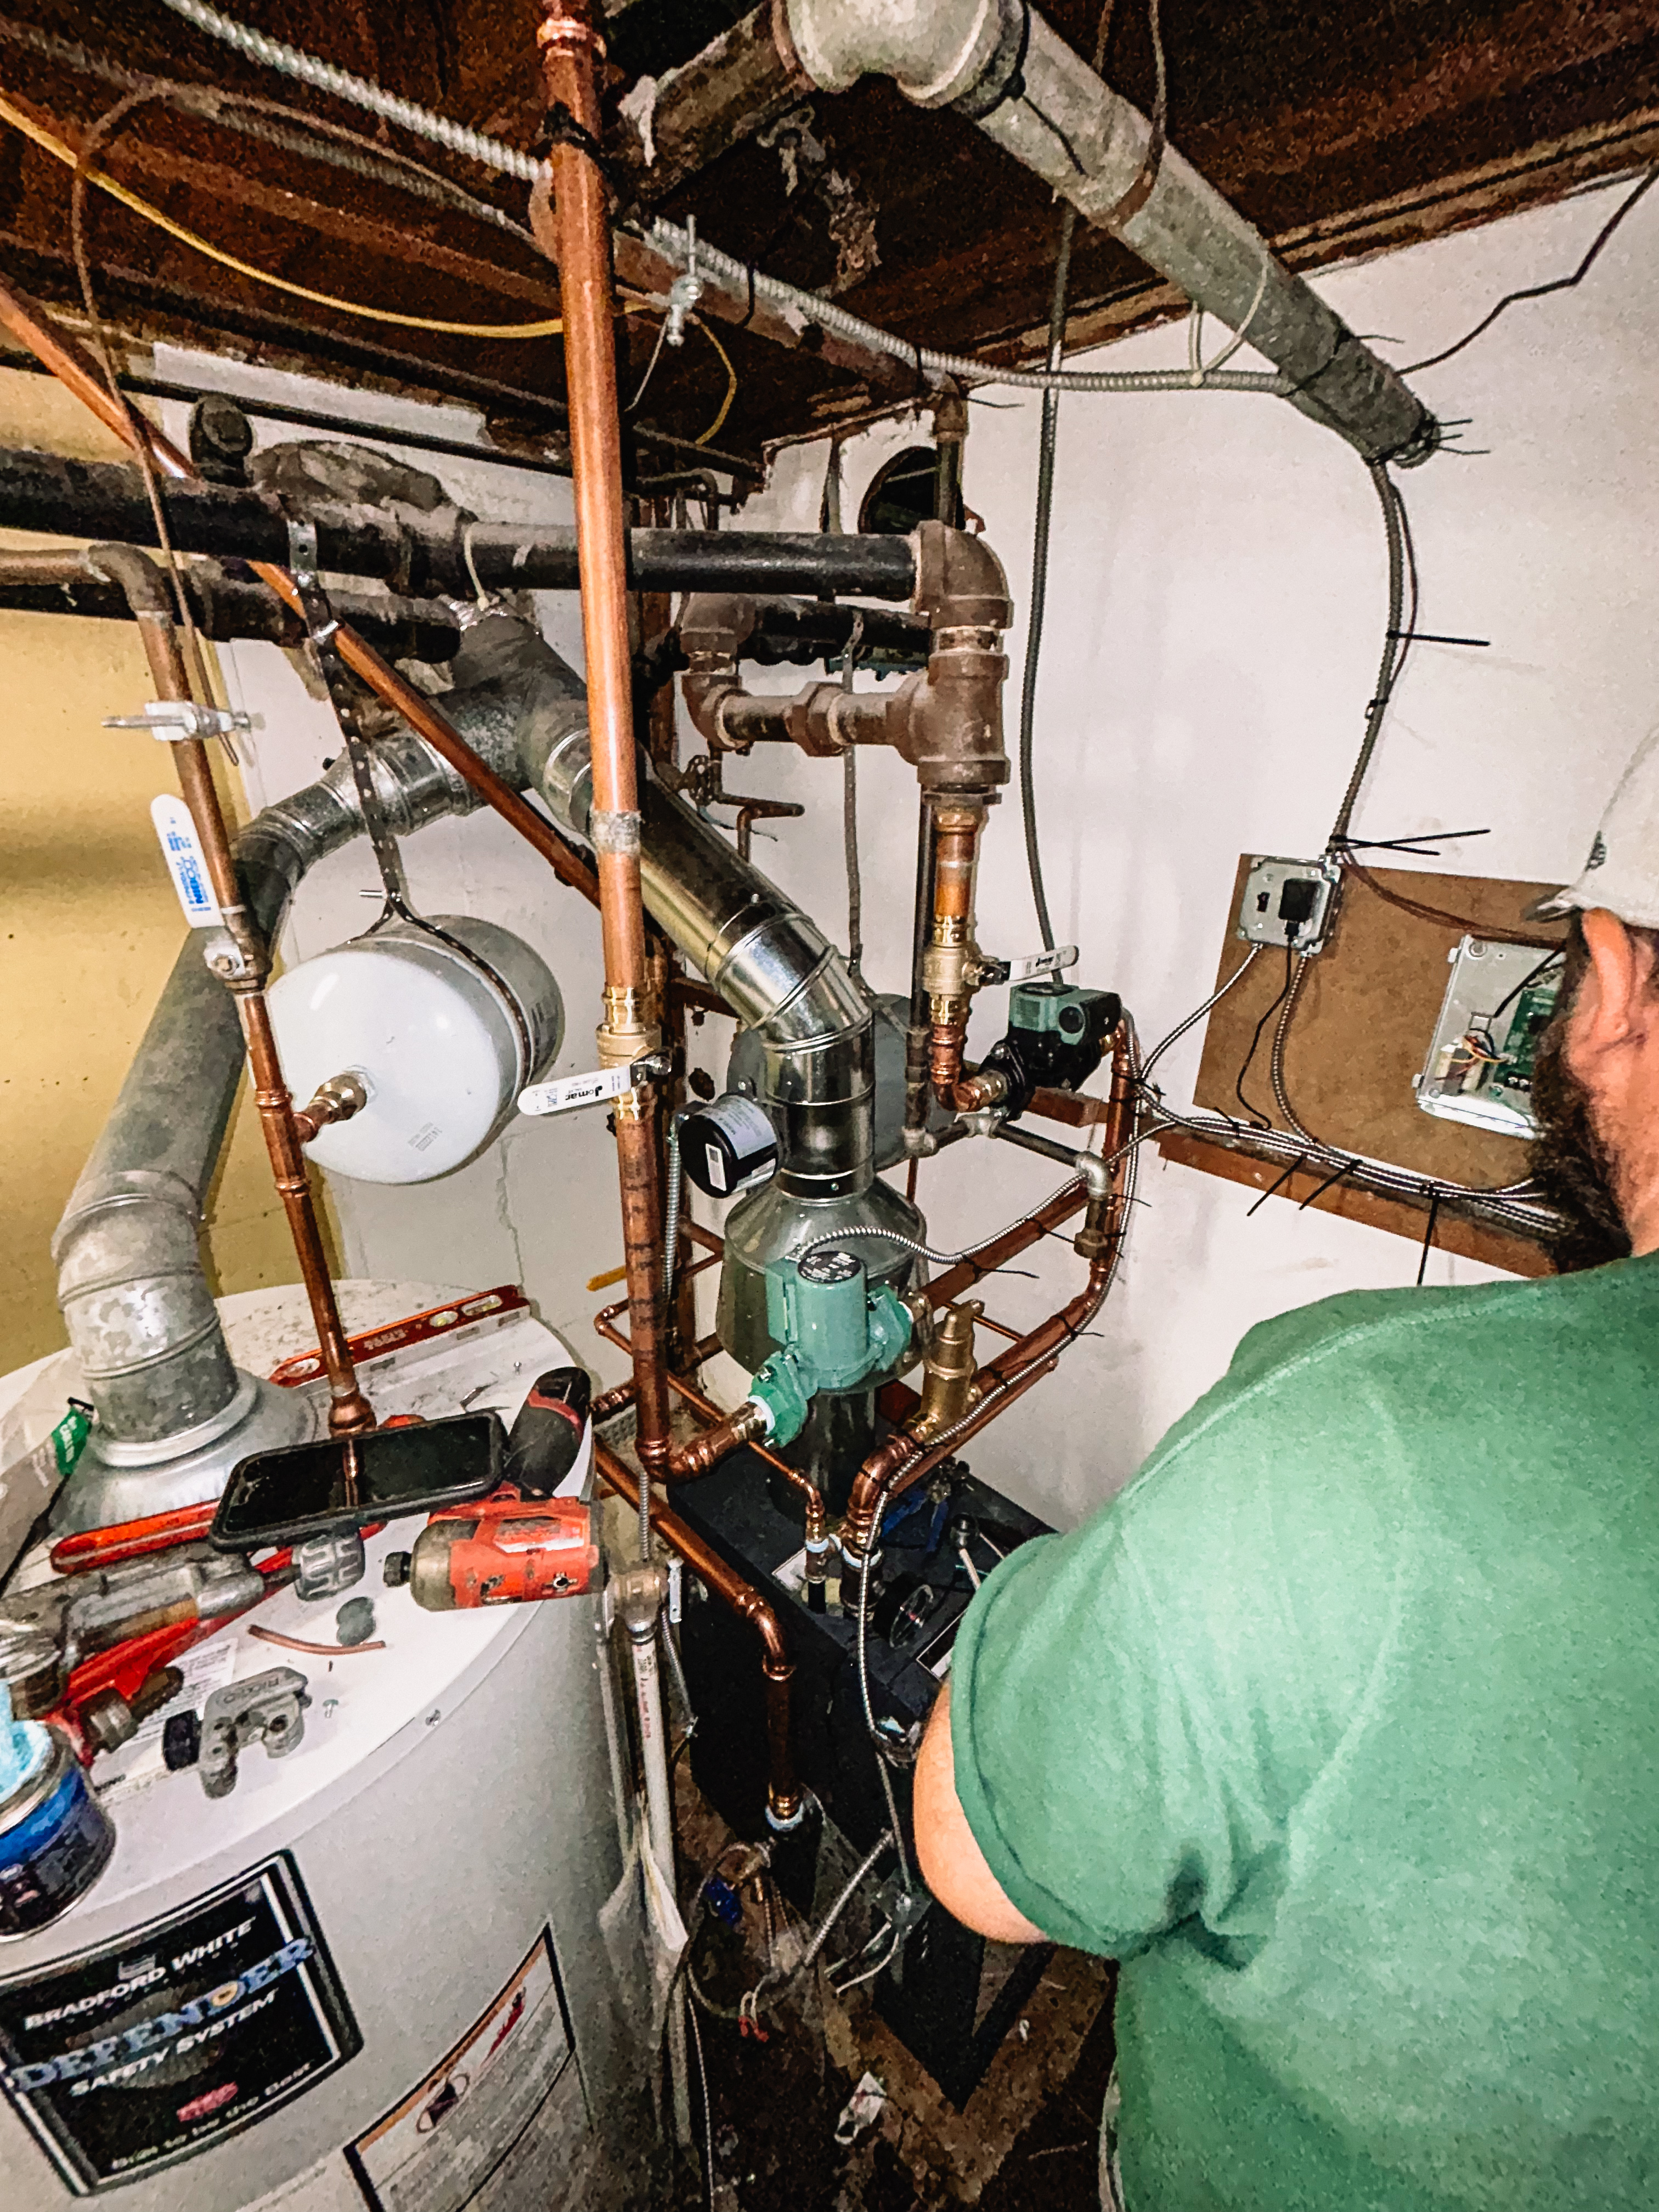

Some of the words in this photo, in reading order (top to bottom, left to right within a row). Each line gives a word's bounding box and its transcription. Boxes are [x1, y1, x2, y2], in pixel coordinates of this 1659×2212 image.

[565, 1086, 602, 1101] Jomar
[9, 1938, 315, 2092] DEFENDER
[24, 1967, 166, 2030] BRADFORD
[171, 1918, 254, 1972] WHITE
[70, 2046, 170, 2097] SAFETY
[176, 1990, 276, 2055] SYSTEM
